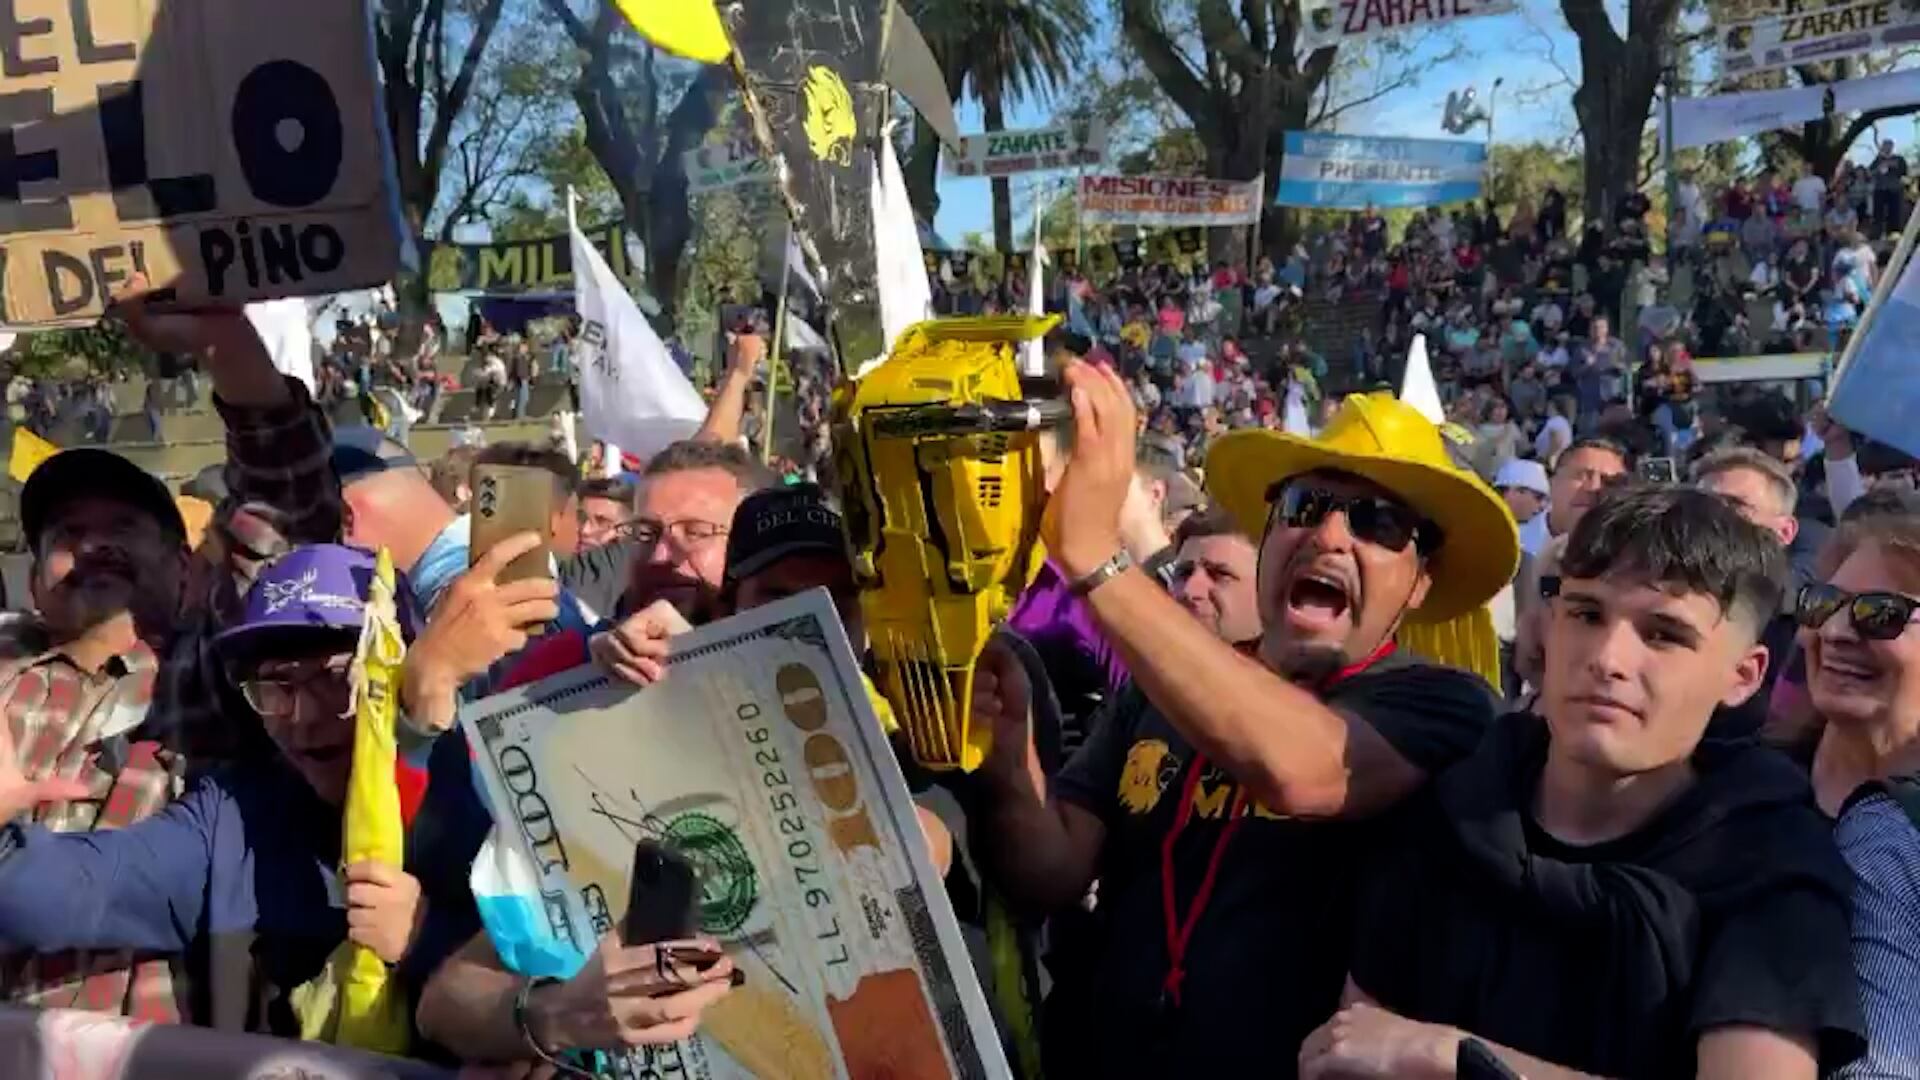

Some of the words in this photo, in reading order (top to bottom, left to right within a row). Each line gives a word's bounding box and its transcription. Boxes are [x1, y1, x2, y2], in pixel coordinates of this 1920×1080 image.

[1781, 4, 1889, 41] ZARATE
[1319, 159, 1441, 181] PRESENTE
[1083, 175, 1228, 198] MISIONES
[475, 226, 628, 289] MILI
